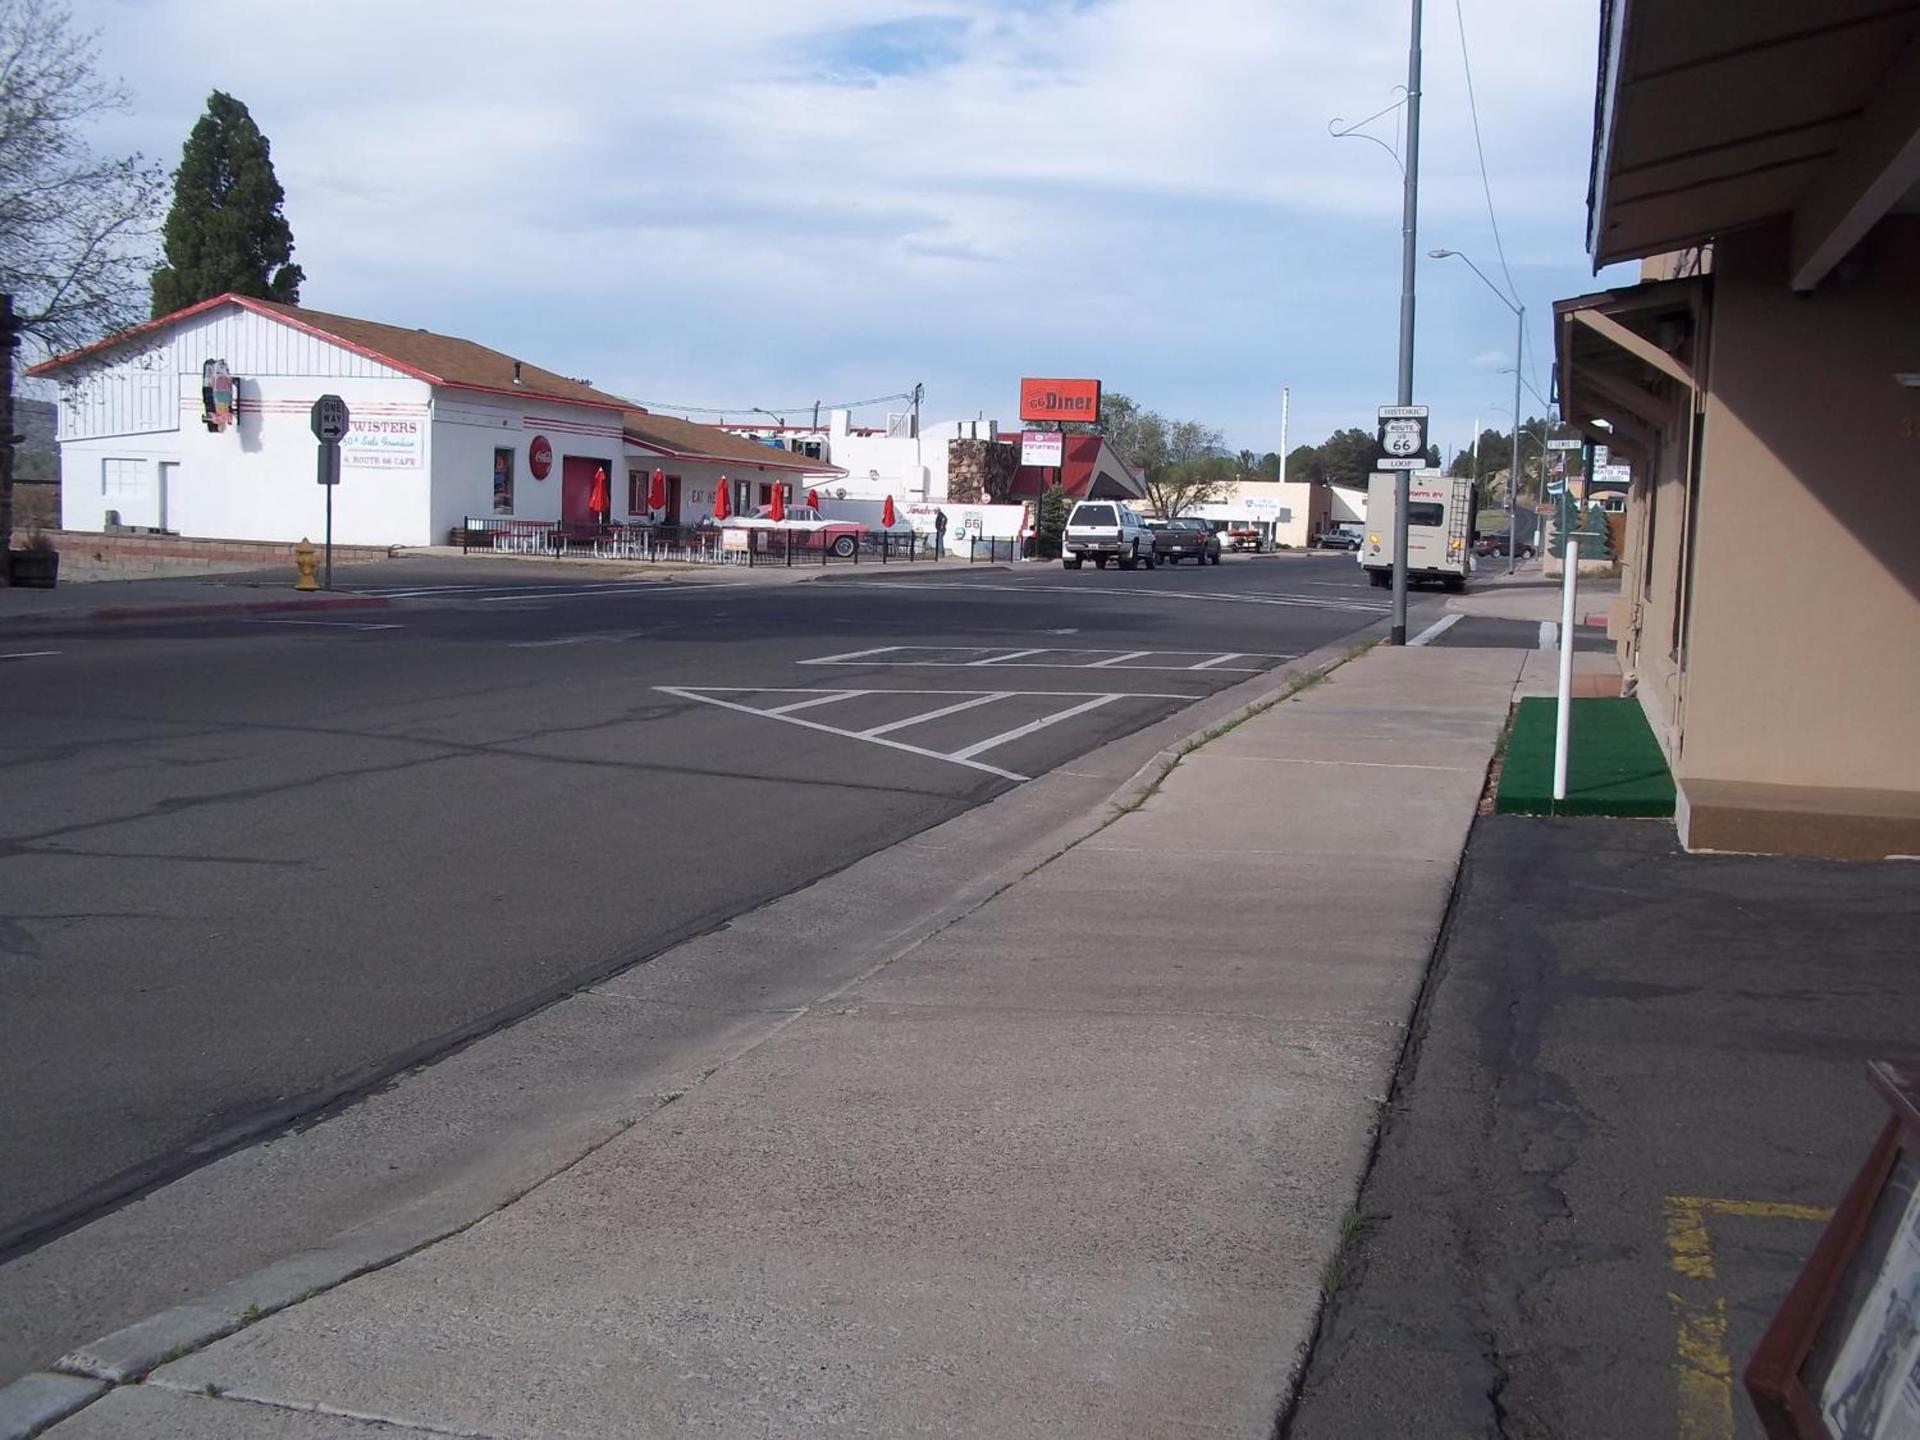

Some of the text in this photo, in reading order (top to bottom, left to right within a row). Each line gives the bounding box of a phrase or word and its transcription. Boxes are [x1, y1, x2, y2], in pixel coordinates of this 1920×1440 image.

[1046, 391, 1092, 411] Diner
[323, 401, 341, 413] ONE
[1384, 407, 1424, 416] HISTORIC
[323, 413, 343, 423] WAY
[1391, 424, 1415, 432] ROUTE
[1393, 439, 1411, 452] 66
[394, 458, 416, 466] CAFE
[1391, 460, 1413, 468] LOOP
[964, 518, 981, 529] 66
